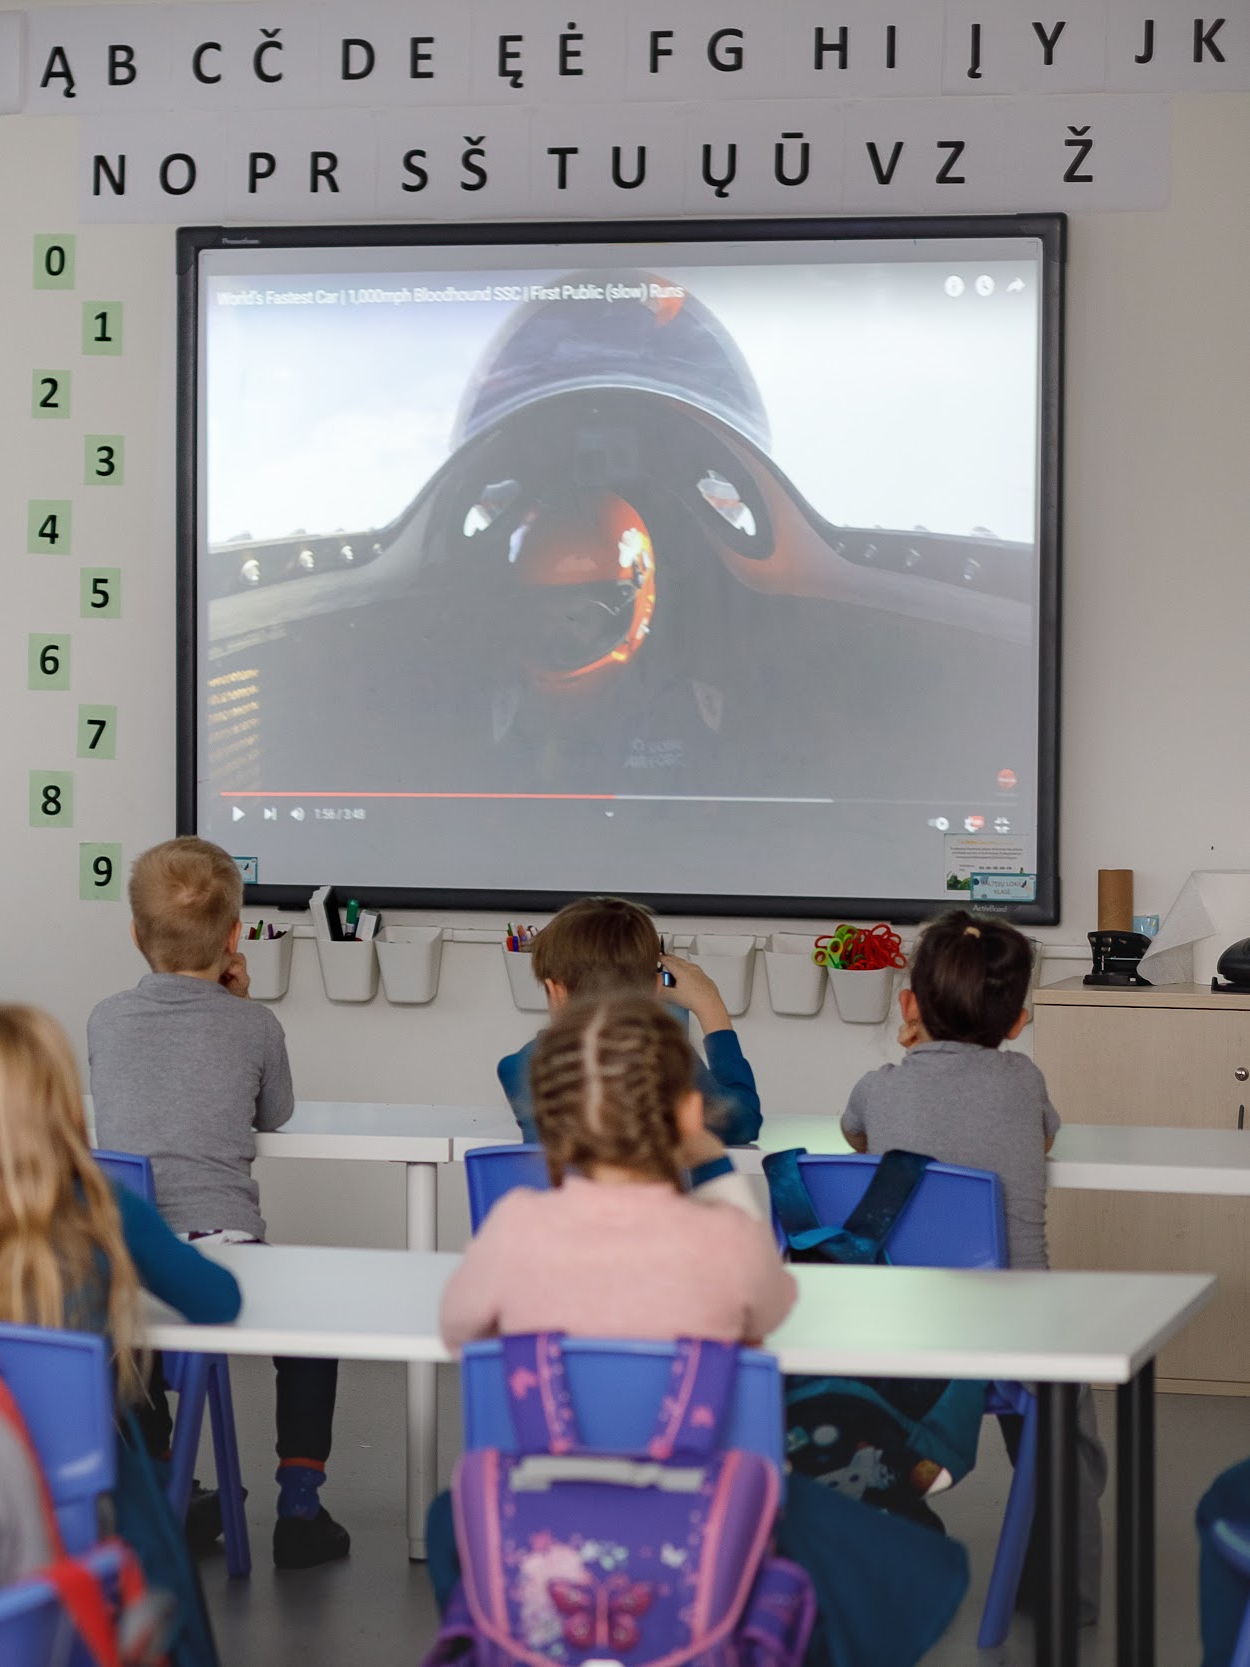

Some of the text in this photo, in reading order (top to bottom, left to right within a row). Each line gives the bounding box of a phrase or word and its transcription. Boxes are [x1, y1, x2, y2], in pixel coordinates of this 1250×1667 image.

[40, 46, 77, 99] Ą
[108, 44, 137, 86] B
[192, 41, 222, 85] C
[253, 28, 283, 83] Č
[341, 38, 376, 81] D
[410, 36, 435, 79] E
[498, 34, 524, 89] Ę
[558, 21, 584, 76] Ė
[649, 30, 674, 74] F
[707, 27, 744, 73] G
[814, 26, 849, 71] H
[886, 25, 896, 69] I
[967, 23, 983, 79] Į
[1031, 21, 1067, 66] Y
[1134, 19, 1155, 65] J
[1193, 17, 1226, 63] K
[93, 125, 1094, 199] N O P R S Š T U Ų Ū V Z Ž
[45, 245, 66, 277] 0
[266, 289, 314, 305] Fastest
[315, 289, 339, 304] Car
[414, 286, 492, 303] Bloodhound
[493, 285, 522, 302] SSC
[530, 285, 561, 301] First
[562, 284, 604, 301] Public
[606, 282, 647, 303] (slow)
[650, 283, 685, 299] Runs
[94, 311, 112, 342] 1
[39, 377, 59, 408] 2
[95, 445, 115, 477] 3
[38, 514, 59, 545] 4
[90, 577, 110, 609] 5
[39, 644, 60, 675] 6
[87, 719, 107, 750] 7
[41, 784, 62, 816] 8
[92, 856, 113, 887] 9
